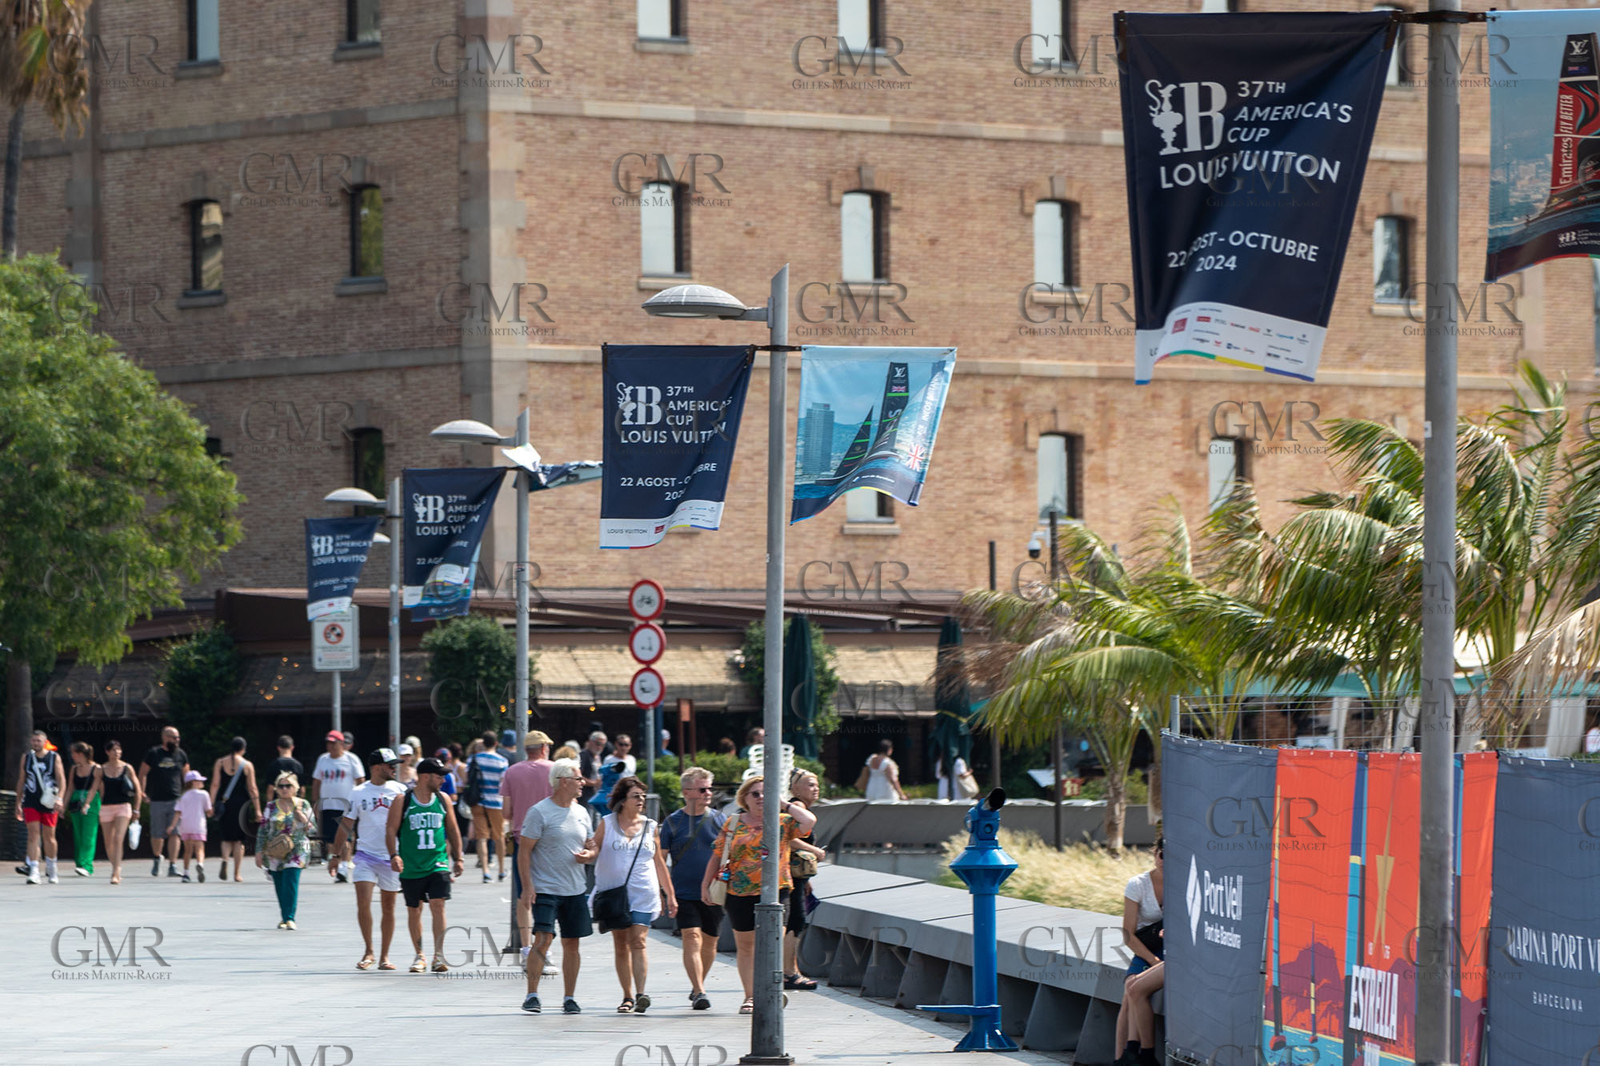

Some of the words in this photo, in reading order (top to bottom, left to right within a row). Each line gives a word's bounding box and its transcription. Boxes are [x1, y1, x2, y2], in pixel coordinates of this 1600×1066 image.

[1237, 80, 1286, 98] 37TH
[1233, 101, 1353, 123] AMERICA'S
[1560, 94, 1573, 121] BETTER
[1227, 127, 1270, 143] CUP
[1160, 156, 1229, 189] LOUIS
[1231, 150, 1341, 183] VUITTON
[1167, 250, 1187, 268] 22
[1229, 230, 1319, 262] OCTUBRE
[1195, 254, 1237, 272] 2024
[666, 385, 694, 397] 37TH
[666, 415, 694, 425] CUP
[620, 430, 667, 443] LOUIS
[620, 477, 633, 487] 22
[636, 477, 677, 487] AGOST
[416, 526, 449, 536] LOUIS
[409, 812, 444, 830] BOSTON
[417, 829, 436, 849] 11
[1204, 870, 1224, 918] Port
[1224, 875, 1243, 921] Vell
[1507, 924, 1548, 965] MARINA
[1551, 931, 1584, 971] PORT
[1348, 964, 1399, 1040] ESTRELLA
[1532, 991, 1583, 1012] BARCELONA
